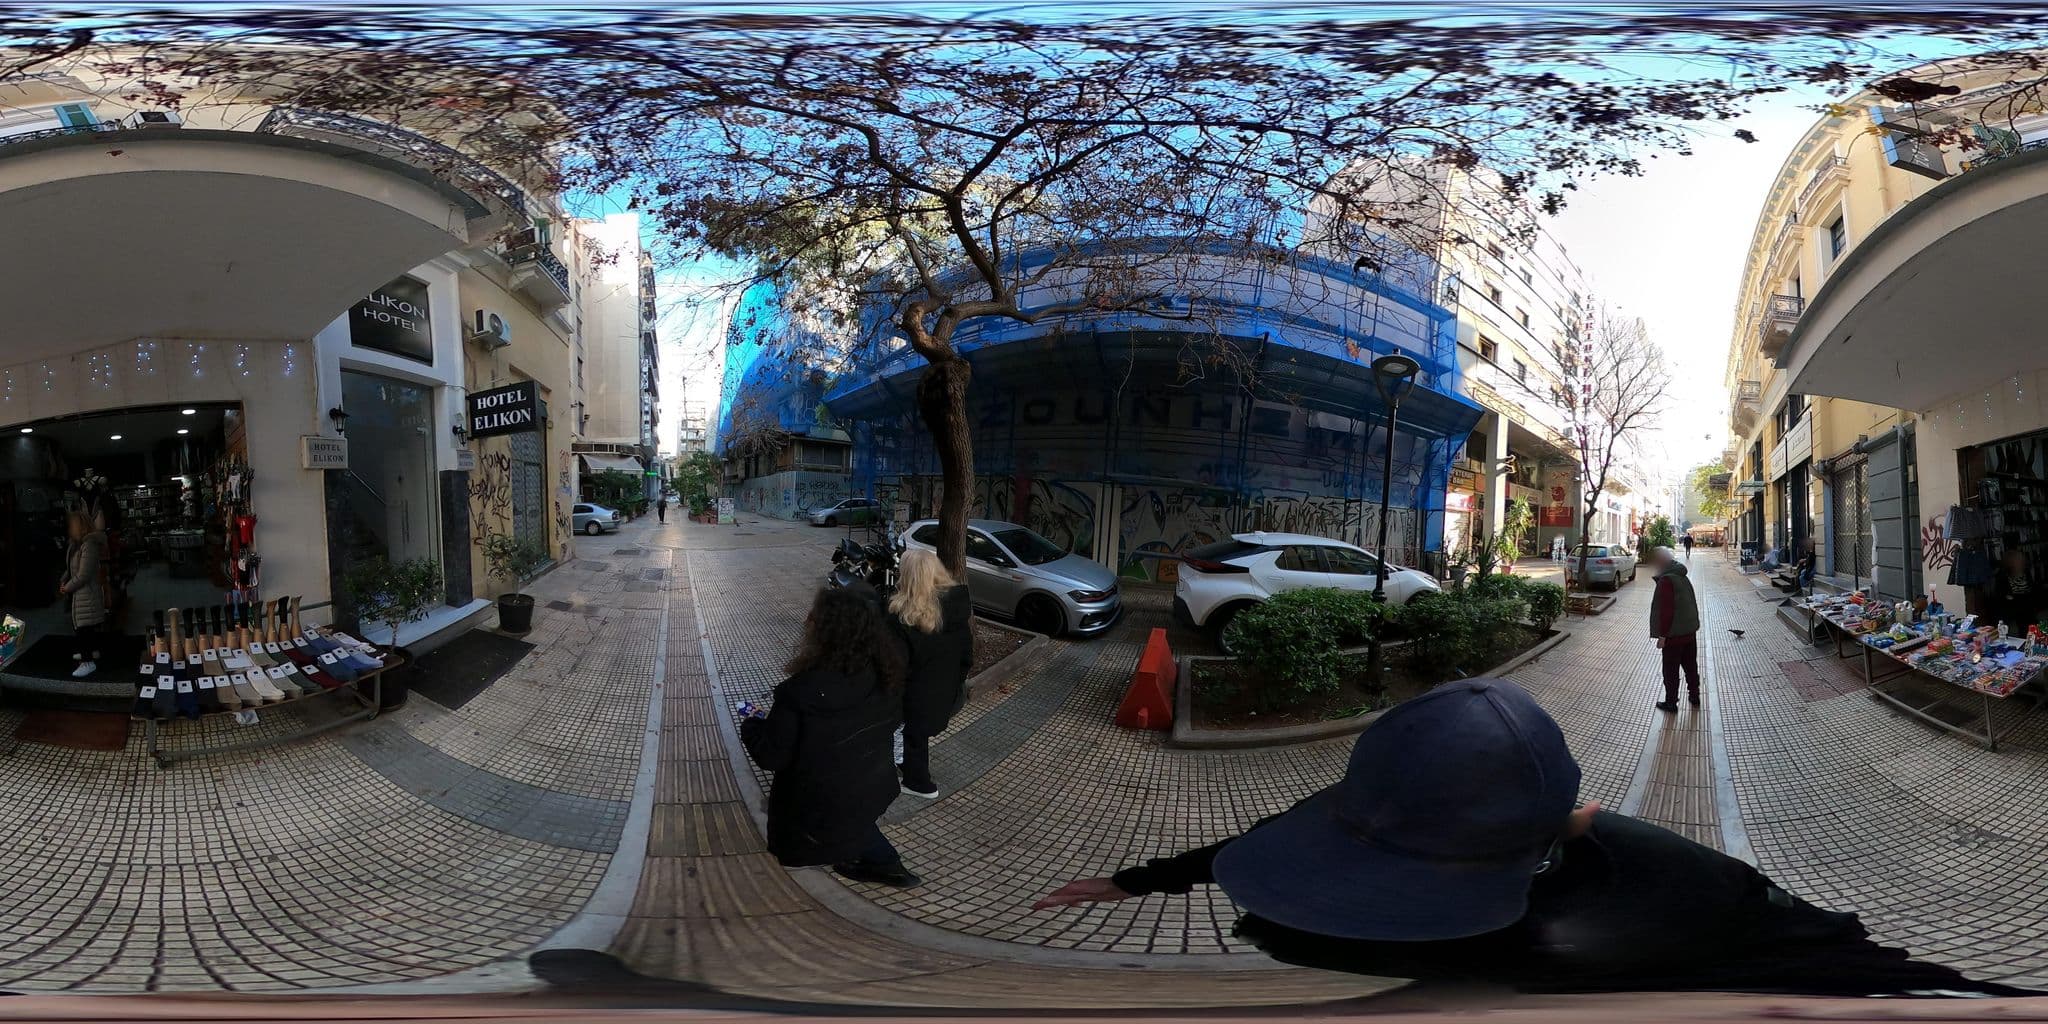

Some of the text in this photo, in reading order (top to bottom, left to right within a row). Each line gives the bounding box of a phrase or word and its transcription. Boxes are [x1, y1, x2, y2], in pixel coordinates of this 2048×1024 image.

[363, 293, 426, 320] LIKON
[363, 307, 421, 333] HOTEL
[476, 389, 527, 410] HOTEL
[473, 407, 532, 430] ELIKON
[313, 442, 342, 452] HOTEL
[313, 454, 345, 463] ELIKON
